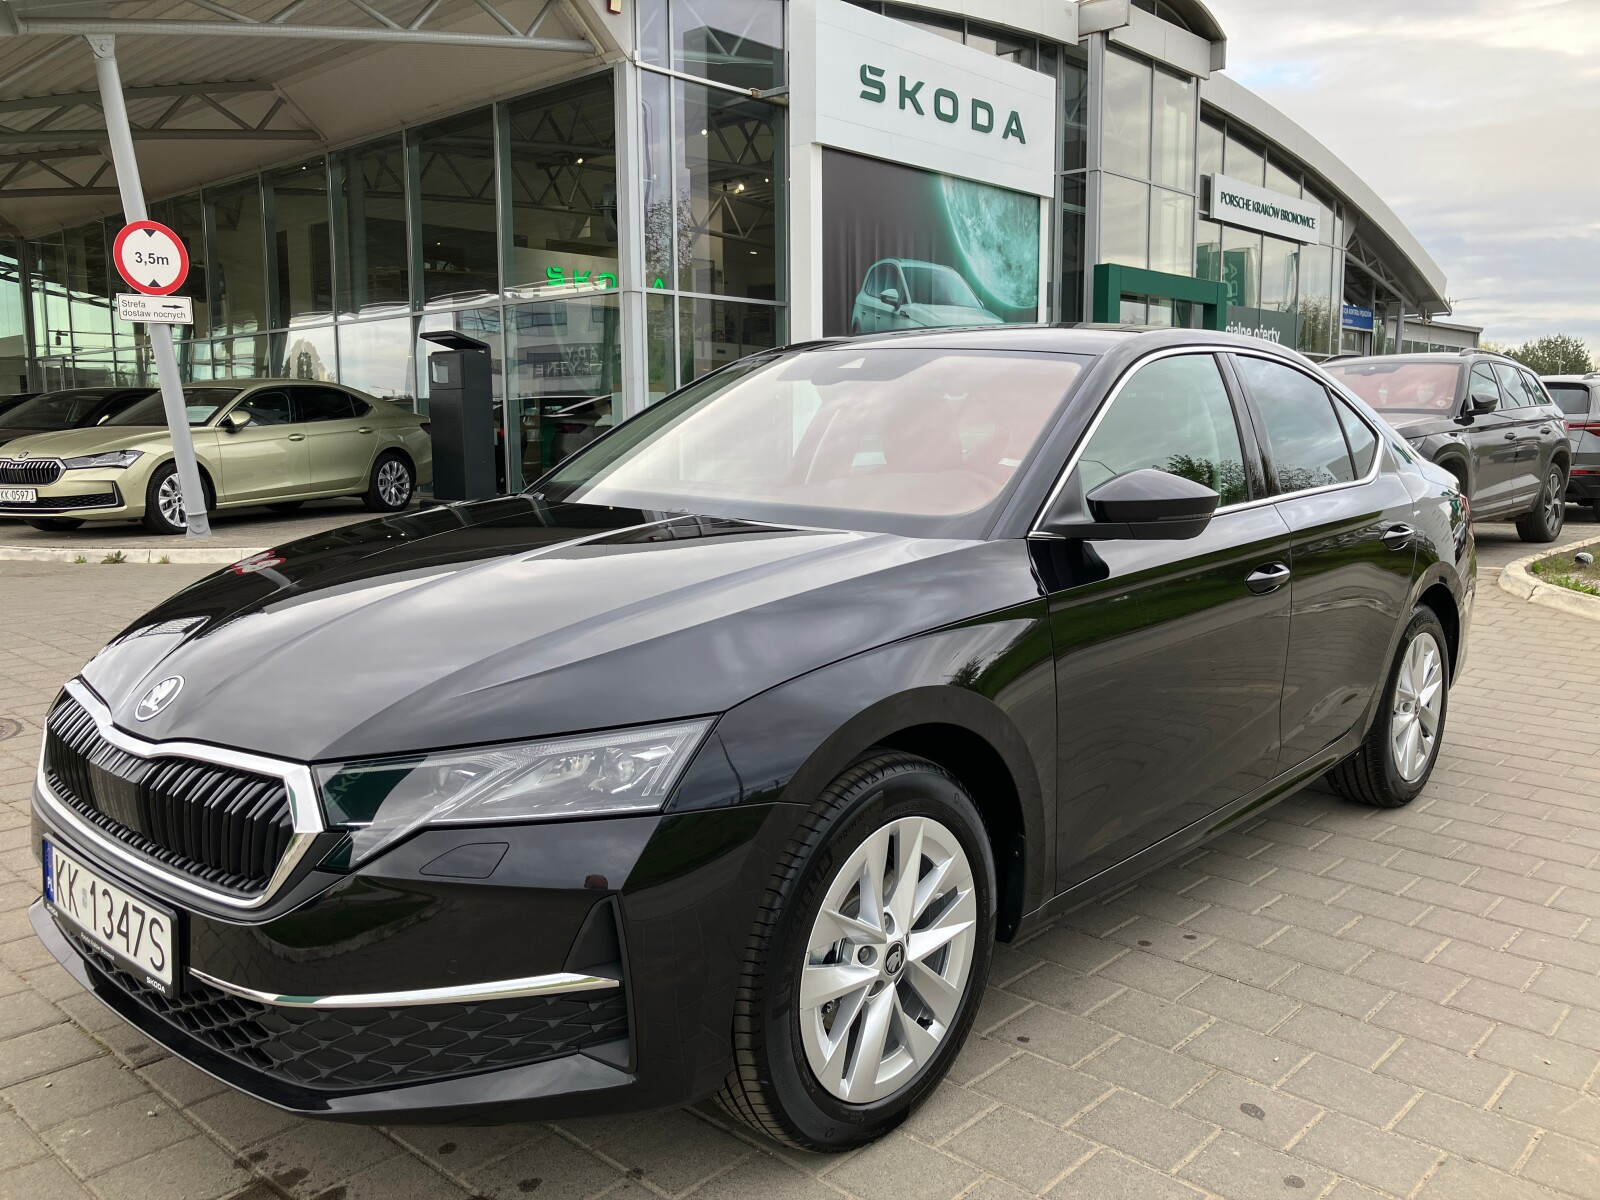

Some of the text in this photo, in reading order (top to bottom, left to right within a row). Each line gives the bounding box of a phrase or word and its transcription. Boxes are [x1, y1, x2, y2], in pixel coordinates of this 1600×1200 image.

[1220, 191, 1316, 229] PORSCHE KRAKÓW BRONOWICE
[134, 251, 170, 266] 3,5m
[546, 266, 665, 290] SKOA
[121, 299, 146, 308] Strefa
[122, 309, 186, 320] dostaw nocnych
[0, 490, 10, 500] KK
[55, 854, 165, 972] KK 1347S
